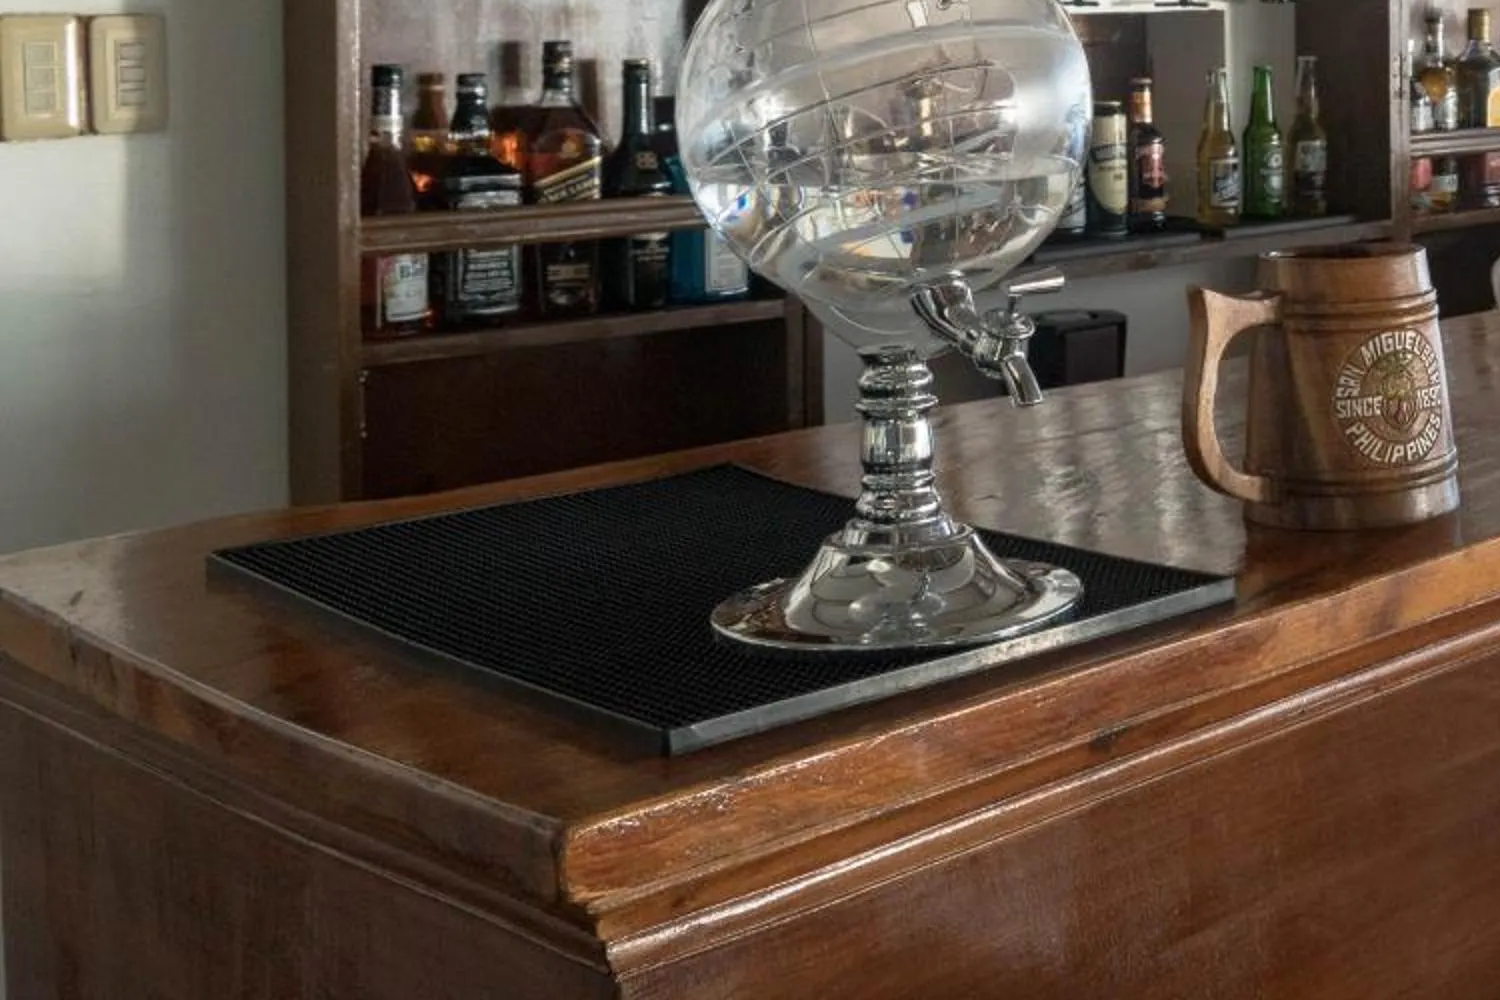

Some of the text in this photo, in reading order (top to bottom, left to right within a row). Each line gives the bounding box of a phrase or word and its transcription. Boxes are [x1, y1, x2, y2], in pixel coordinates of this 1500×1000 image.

[1336, 360, 1368, 398] SAN
[1361, 329, 1422, 368] MIGUEL
[1335, 396, 1383, 419] SINCE
[1344, 412, 1441, 463] PHILIPPINES
